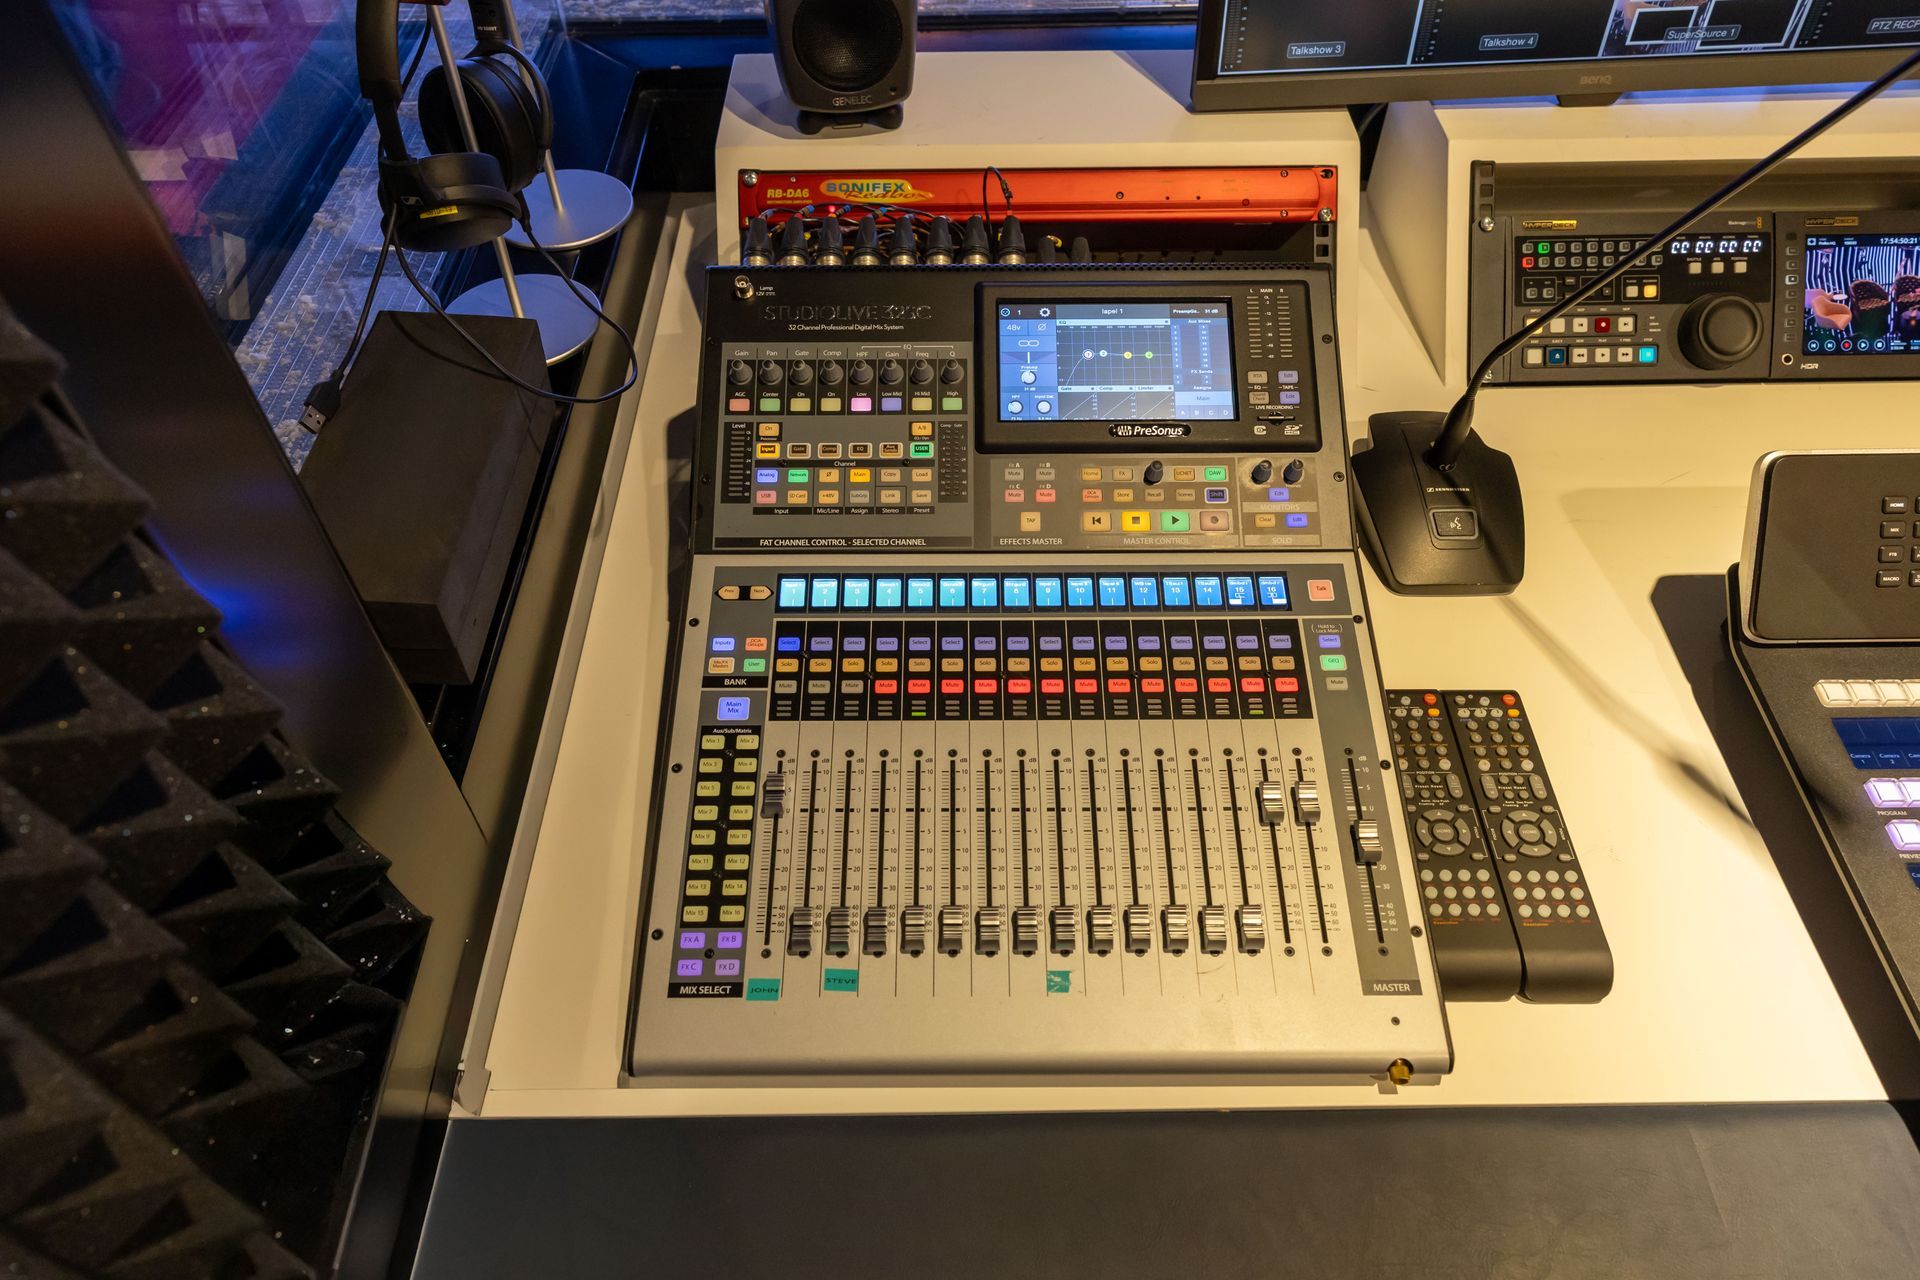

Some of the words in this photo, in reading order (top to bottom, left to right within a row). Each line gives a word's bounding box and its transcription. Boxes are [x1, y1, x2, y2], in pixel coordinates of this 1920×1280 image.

[1871, 21, 1891, 30] PTZ
[1667, 28, 1728, 39] SuperSource
[1730, 28, 1735, 36] 1
[1484, 38, 1526, 47] Talkshow
[1528, 36, 1534, 44] 4
[1290, 45, 1332, 55] Talkshow
[1334, 44, 1342, 54] 3
[832, 95, 872, 106] GENELEC
[826, 182, 906, 193] SONIFEX
[766, 188, 810, 199] RB-DA6
[1102, 308, 1118, 316] lapel
[854, 324, 872, 332] Digital
[823, 350, 842, 358] Comp
[1133, 425, 1184, 436] PreSonus
[684, 936, 692, 944] FX
[692, 936, 700, 944] A
[682, 962, 690, 970] FX
[690, 962, 697, 970] C
[680, 986, 698, 994] MIX
[698, 986, 731, 995] SELECT
[1373, 984, 1410, 992] MASTER
